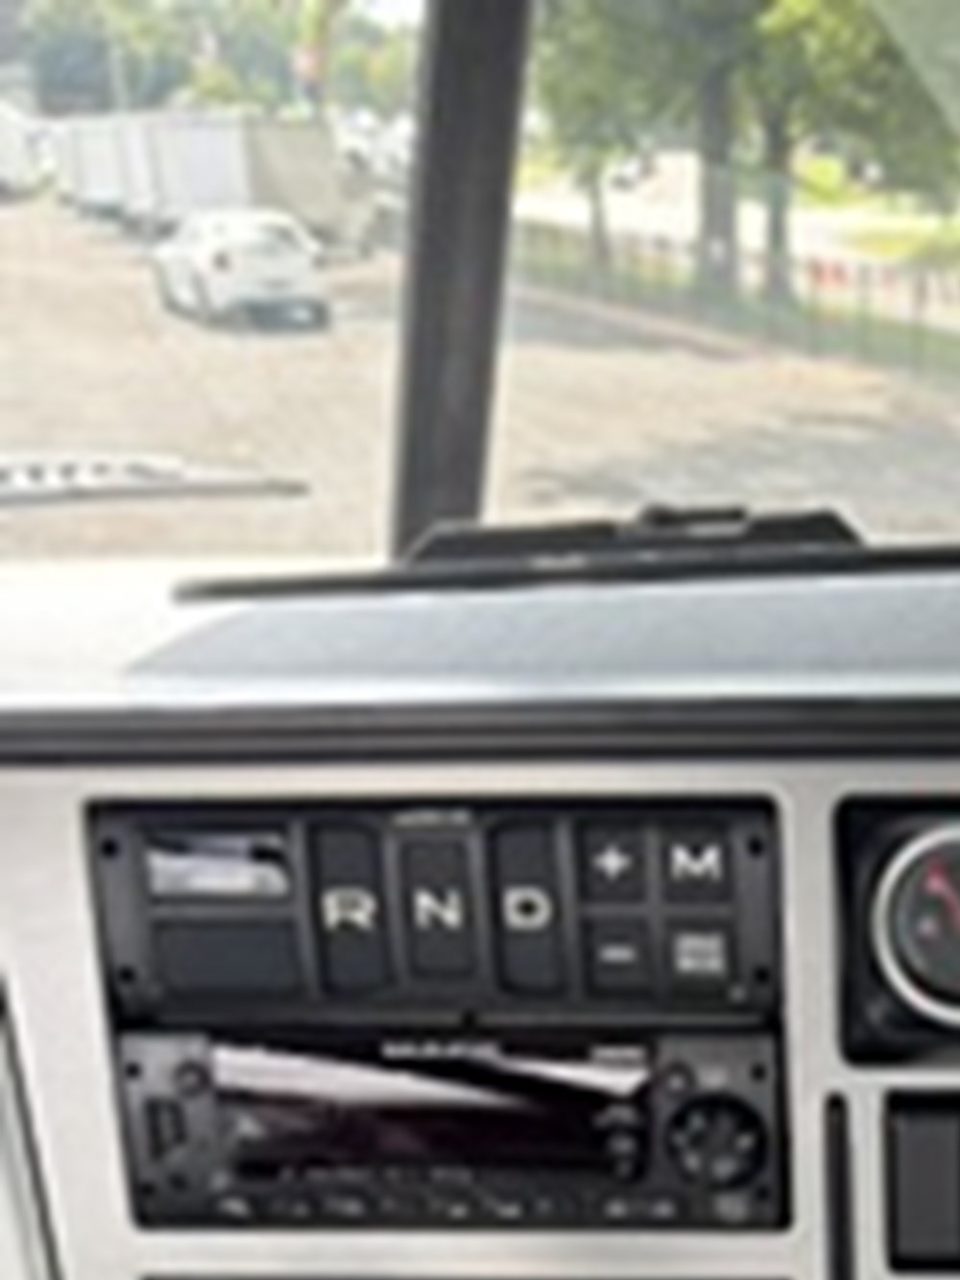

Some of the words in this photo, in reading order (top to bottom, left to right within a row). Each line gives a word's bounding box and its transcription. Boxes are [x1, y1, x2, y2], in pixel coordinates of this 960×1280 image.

[669, 843, 723, 882] M
[321, 886, 378, 931] R
[414, 887, 462, 931] N
[503, 886, 552, 931] D
